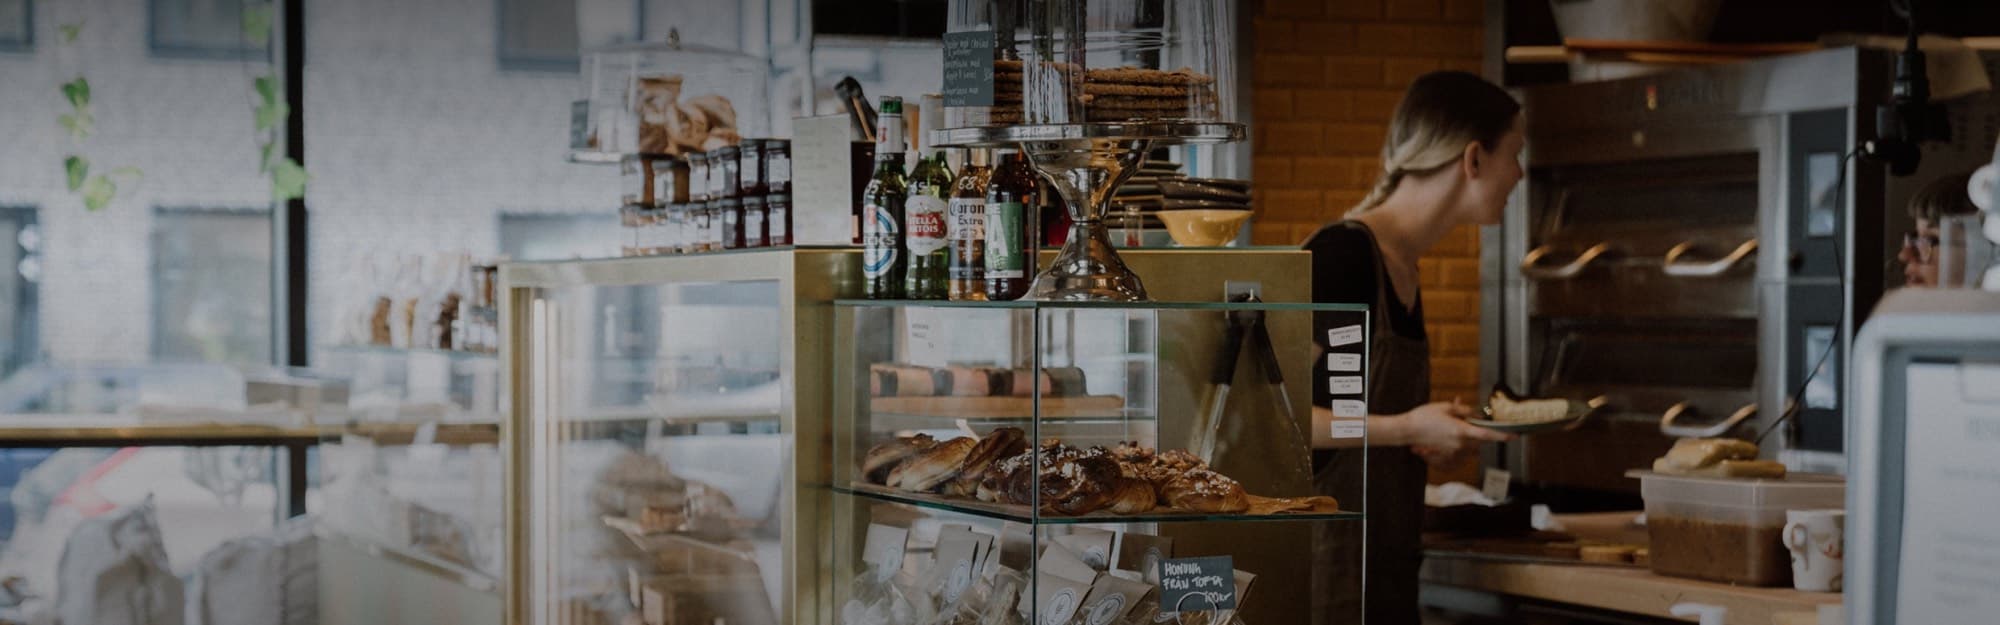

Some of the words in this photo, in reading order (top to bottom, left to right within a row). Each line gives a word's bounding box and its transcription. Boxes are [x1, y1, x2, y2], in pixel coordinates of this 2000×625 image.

[950, 202, 985, 216] Coron
[958, 214, 984, 225] Extra
[1163, 576, 1189, 590] FRÅN
[1192, 575, 1223, 587] TOFTA
